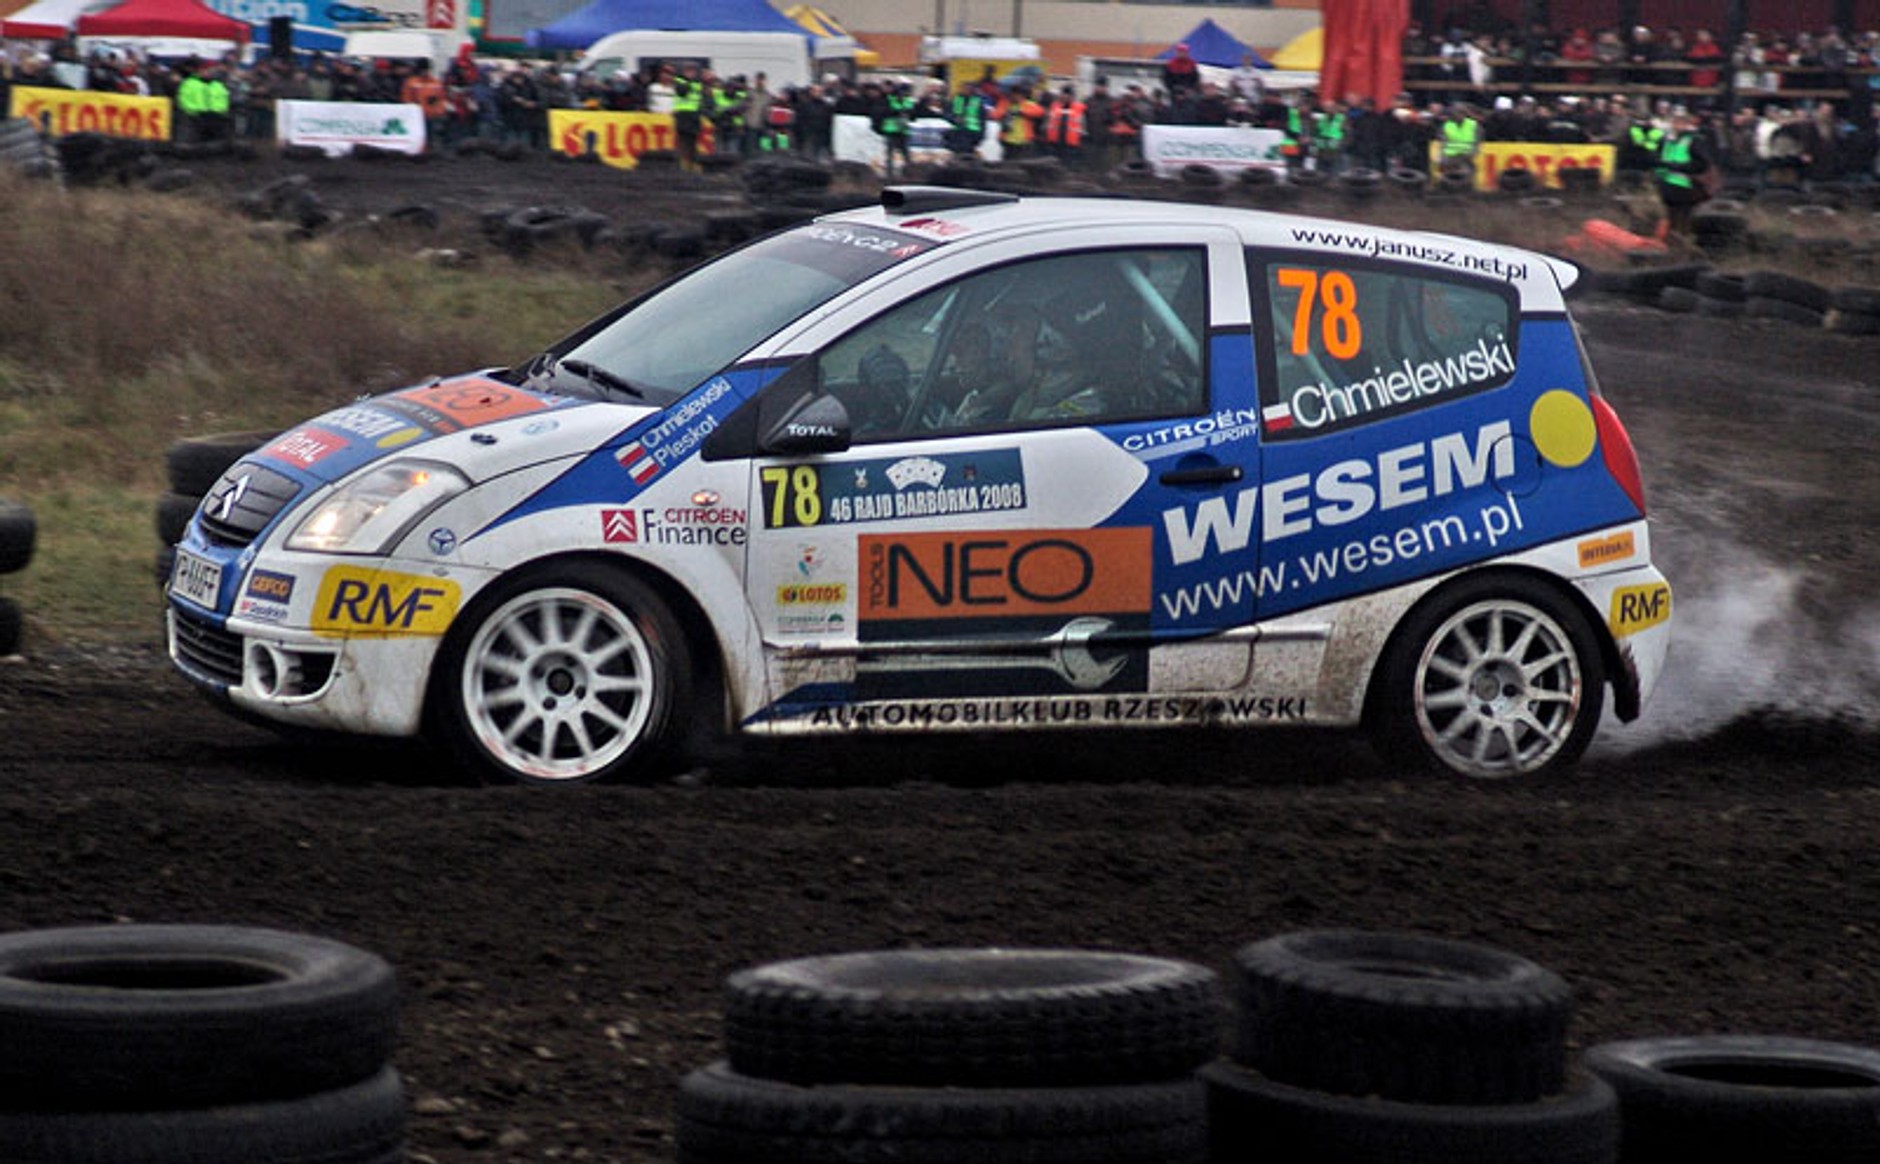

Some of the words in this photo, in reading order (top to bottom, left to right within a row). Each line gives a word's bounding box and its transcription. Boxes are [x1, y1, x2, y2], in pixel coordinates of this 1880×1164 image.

[1277, 268, 1362, 360] 78
[1292, 333, 1515, 428] Chmielewski
[786, 423, 837, 437] TOTAL
[763, 466, 821, 527] 78
[830, 498, 851, 523] 46
[855, 492, 894, 520] RAJD
[981, 482, 1023, 509] 2008
[1162, 420, 1515, 566] WESEM
[643, 511, 746, 546] Finance
[1161, 491, 1524, 620] www.wesem.pl
[329, 579, 445, 628] RMF
[799, 586, 842, 602] LOTOS
[868, 543, 884, 609] TOOLS
[888, 539, 1095, 609] NEO
[1620, 587, 1667, 624] RMF
